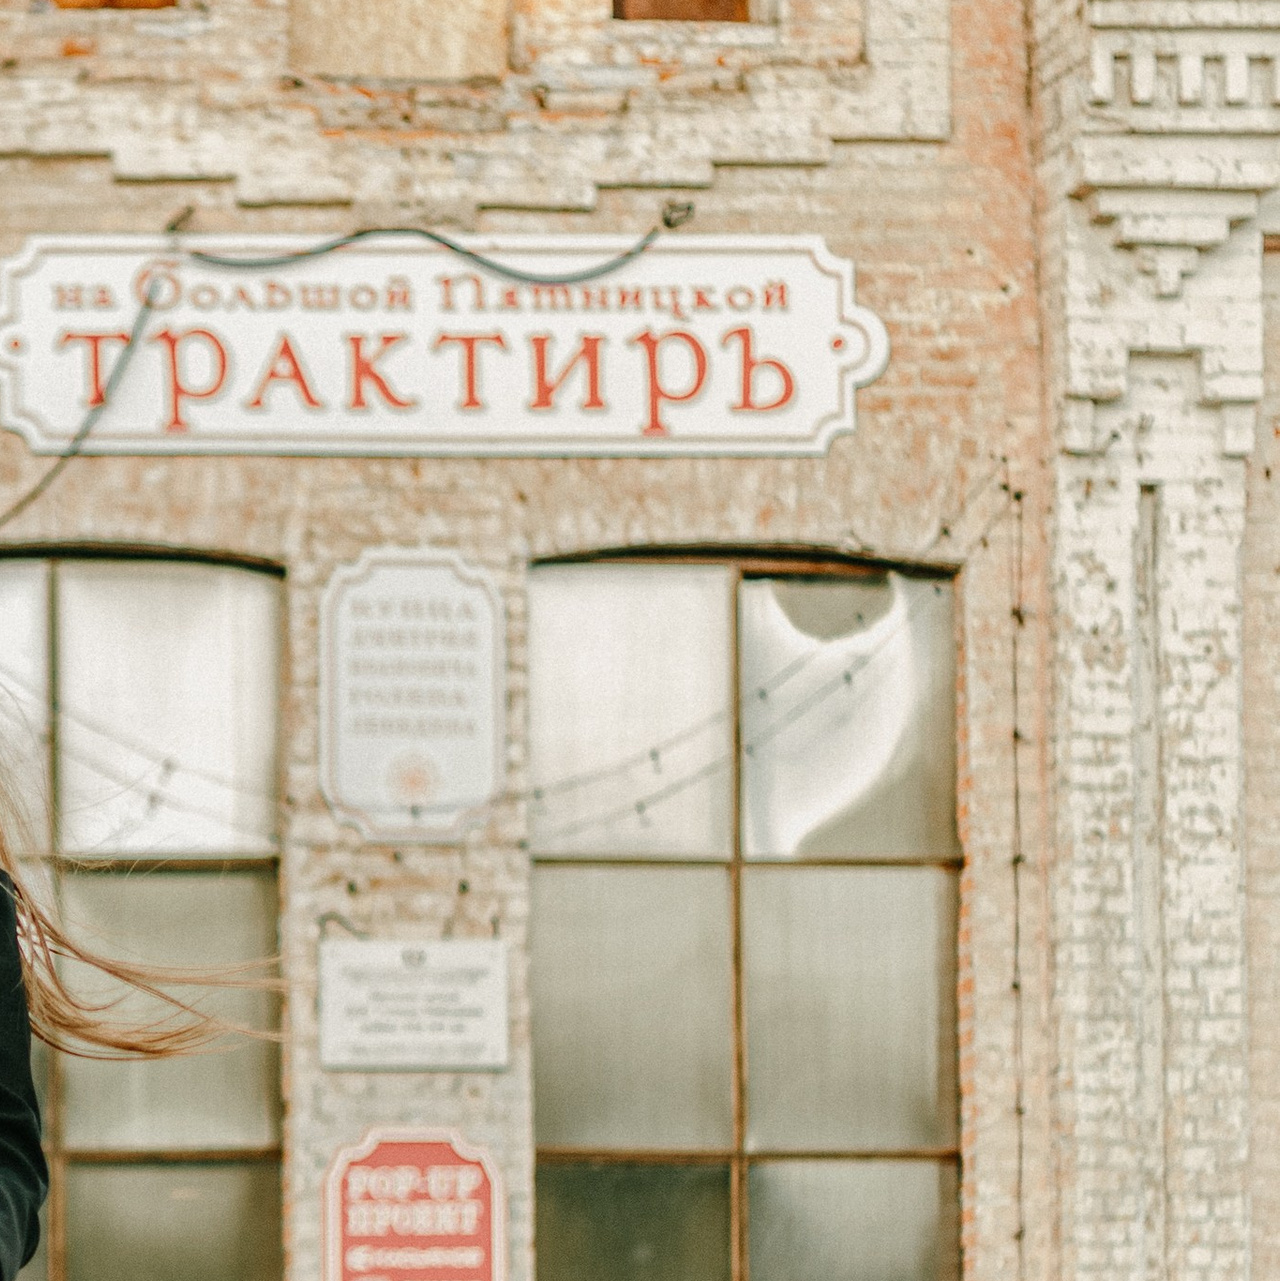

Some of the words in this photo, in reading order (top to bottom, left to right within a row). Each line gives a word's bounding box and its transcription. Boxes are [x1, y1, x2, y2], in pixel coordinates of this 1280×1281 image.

[53, 283, 114, 310] на
[435, 274, 792, 320] Пятницкой
[55, 327, 796, 437] ТРАКТИРЪ
